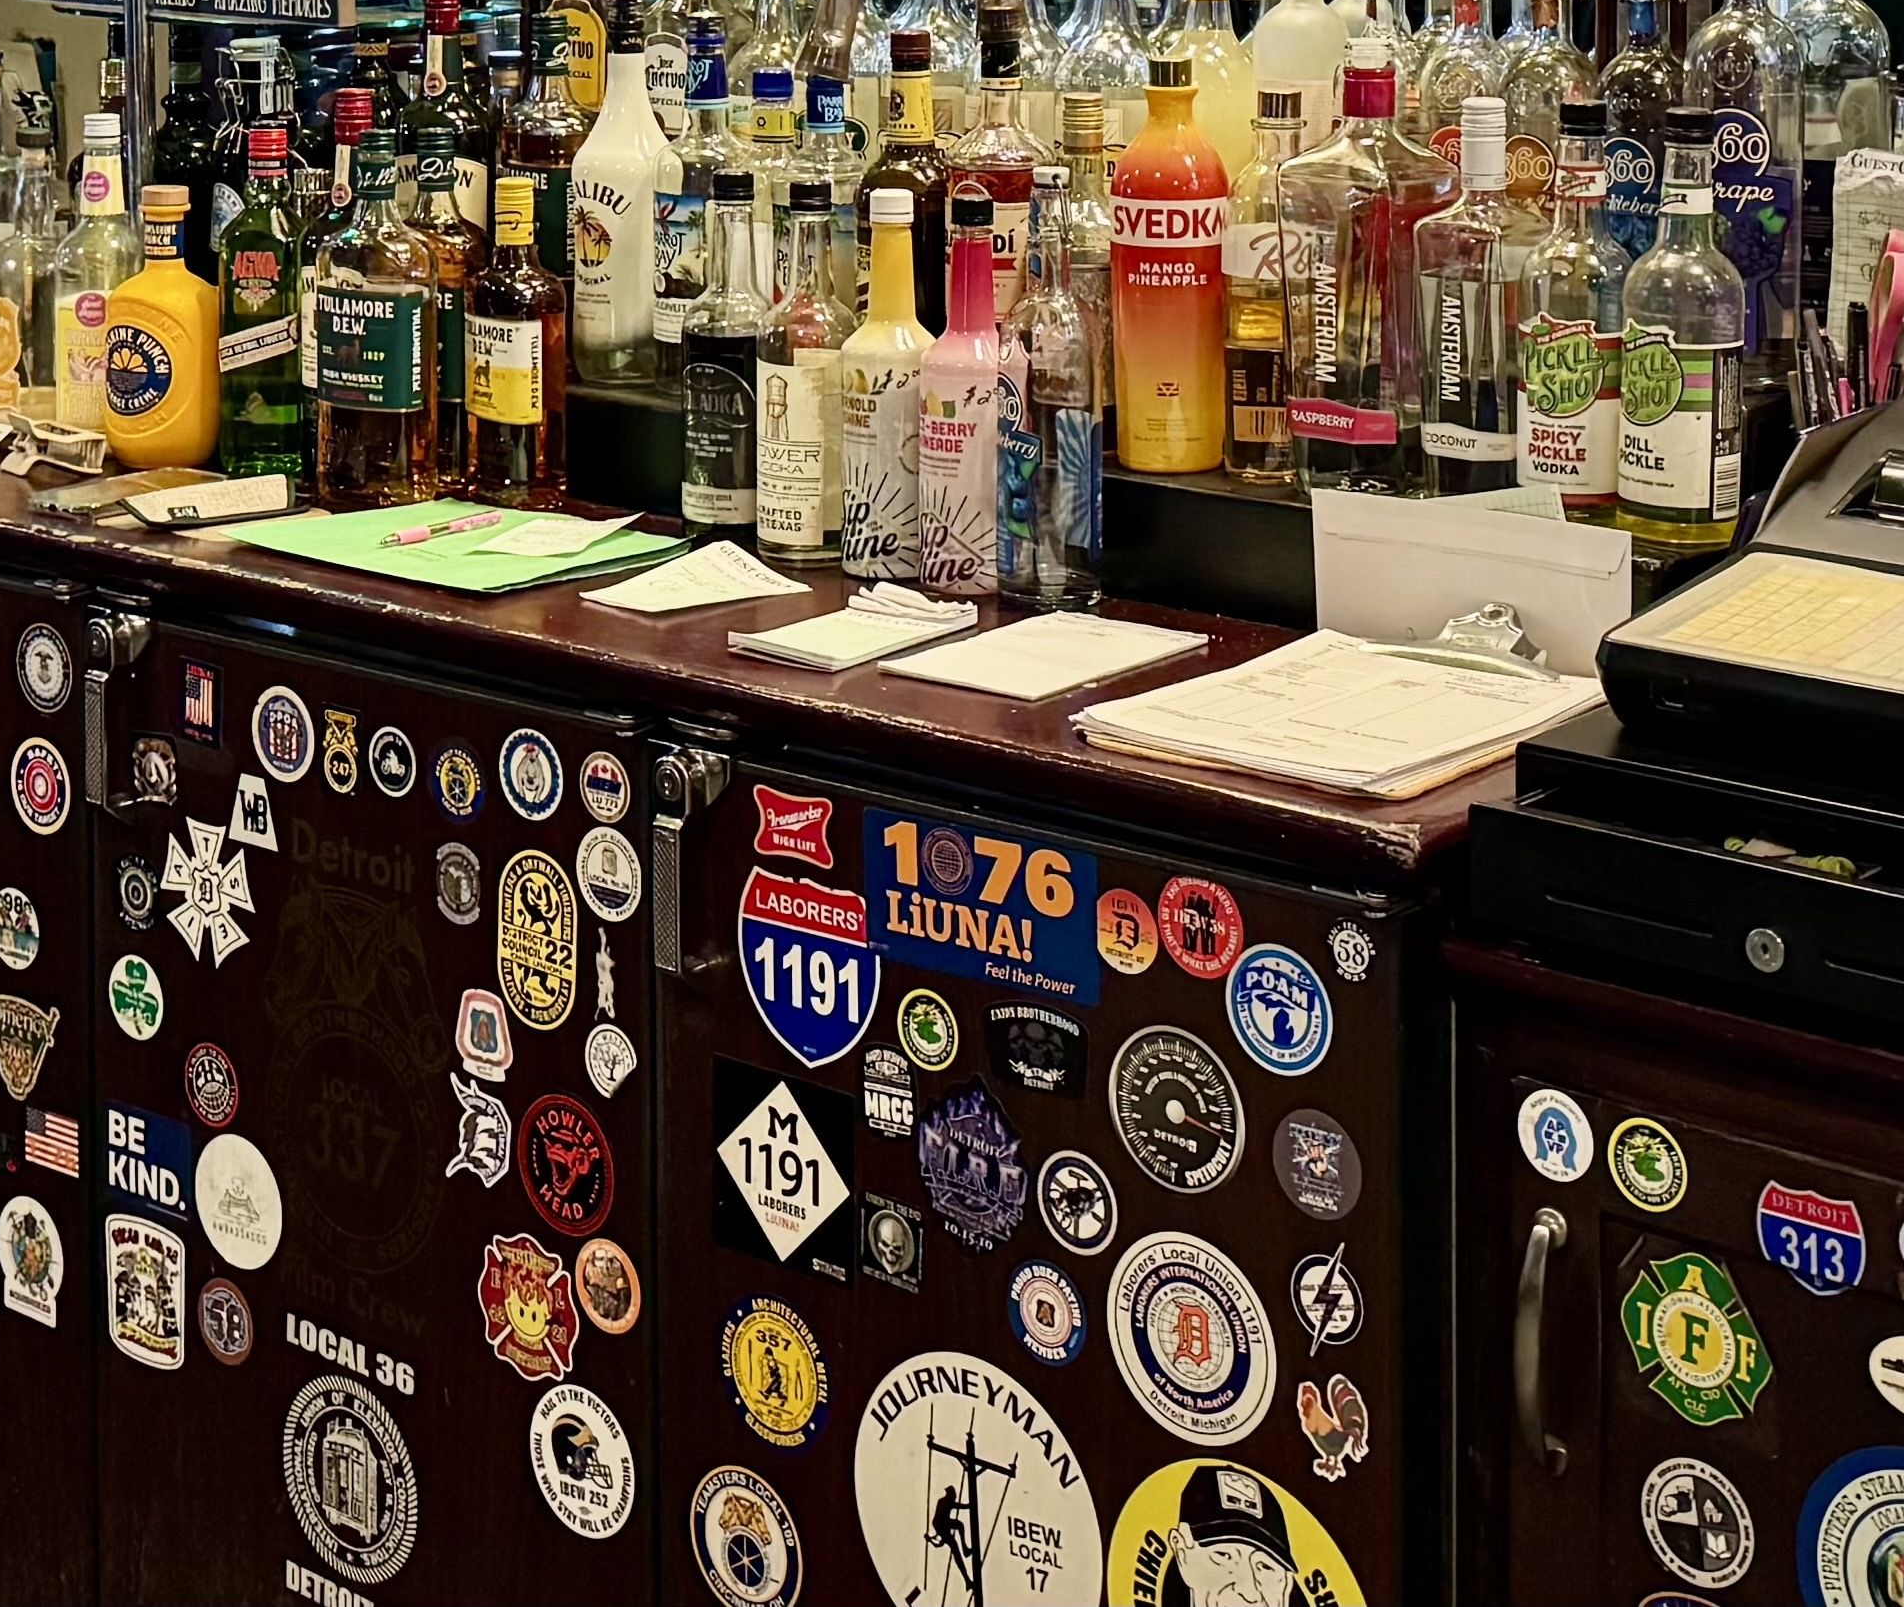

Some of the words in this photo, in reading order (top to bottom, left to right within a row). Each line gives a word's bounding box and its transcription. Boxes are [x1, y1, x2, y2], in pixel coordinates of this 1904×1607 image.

[1128, 274, 1208, 287] PINEAPPLE
[1140, 262, 1196, 274] MANGO
[319, 295, 394, 319] TULLAMORE
[1315, 263, 1336, 383] AMSTERDAM
[1528, 443, 1586, 462] PICKLE
[1532, 428, 1580, 446] SPICY
[1532, 460, 1579, 475] VODKA
[755, 889, 863, 931] LABORERS'
[886, 890, 1033, 961] LiUNA!
[754, 936, 859, 1023] 1191
[985, 962, 1010, 983] Feel
[1012, 968, 1030, 985] the
[1035, 972, 1076, 994] Power
[107, 1108, 144, 1154] BE
[535, 1110, 599, 1161] HOWLER
[107, 1151, 186, 1212] KIND.
[540, 1188, 583, 1221] HEAD
[1772, 1192, 1851, 1224] DETROIT
[1780, 1226, 1844, 1283] 313
[286, 1313, 369, 1378] LOCAL
[376, 1352, 415, 1395] 36
[869, 1365, 1080, 1490] JOURNEYMAN
[1008, 1515, 1063, 1549] IBEW
[1010, 1541, 1063, 1569] LOCAL
[1026, 1567, 1049, 1593] 17
